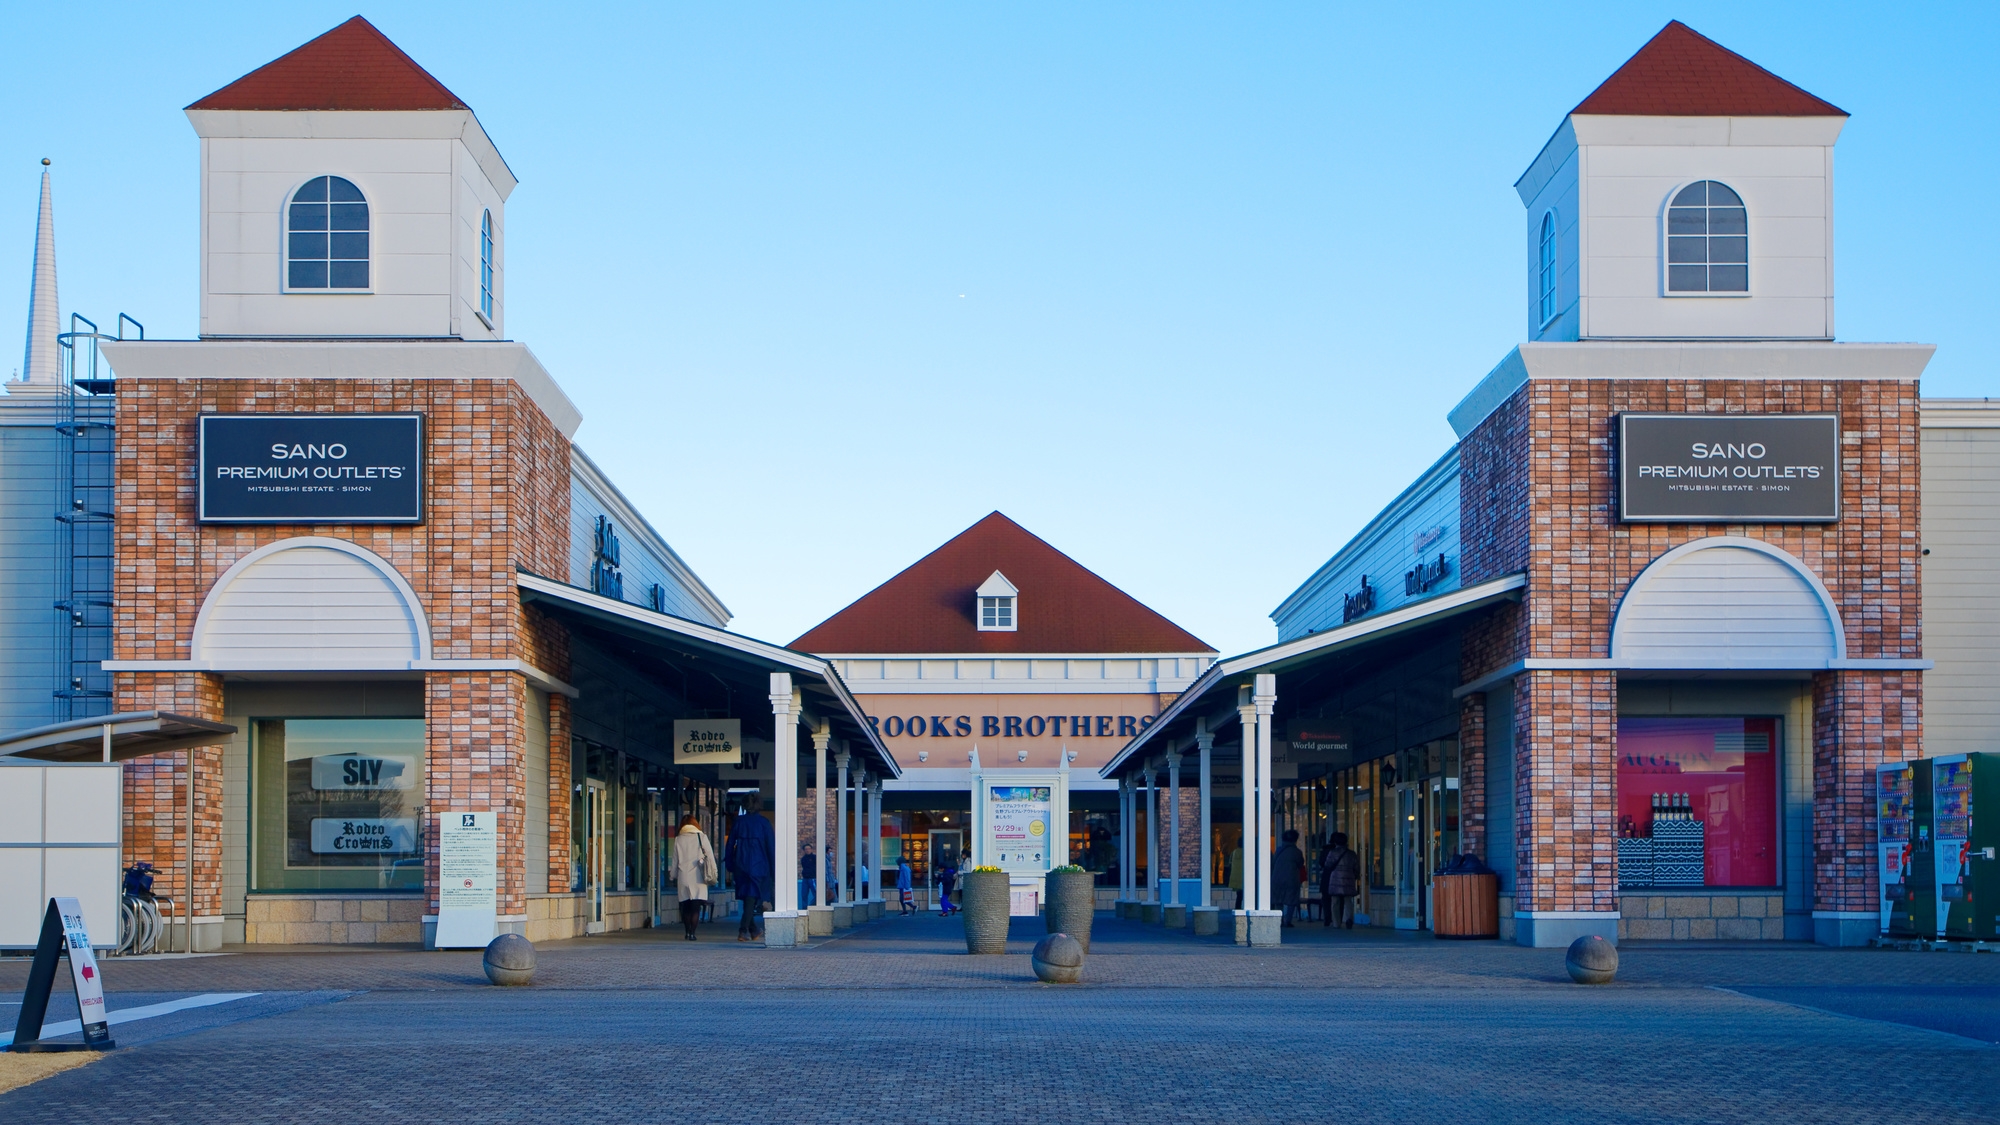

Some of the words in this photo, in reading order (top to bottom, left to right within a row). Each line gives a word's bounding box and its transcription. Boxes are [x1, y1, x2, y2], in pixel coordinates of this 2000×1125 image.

[271, 443, 348, 460] SANO
[1691, 442, 1767, 459] SANO
[217, 466, 308, 479] PREMIUM
[1639, 465, 1728, 478] PREMIUM
[690, 730, 725, 741] Rodeo
[1292, 741, 1316, 750] World
[1316, 742, 1348, 751] gourmet
[734, 752, 760, 770] SLY
[343, 759, 383, 786] SLY
[342, 822, 385, 836] Rodeo
[63, 914, 83, 930] 車いす
[69, 932, 90, 949] 最優先
